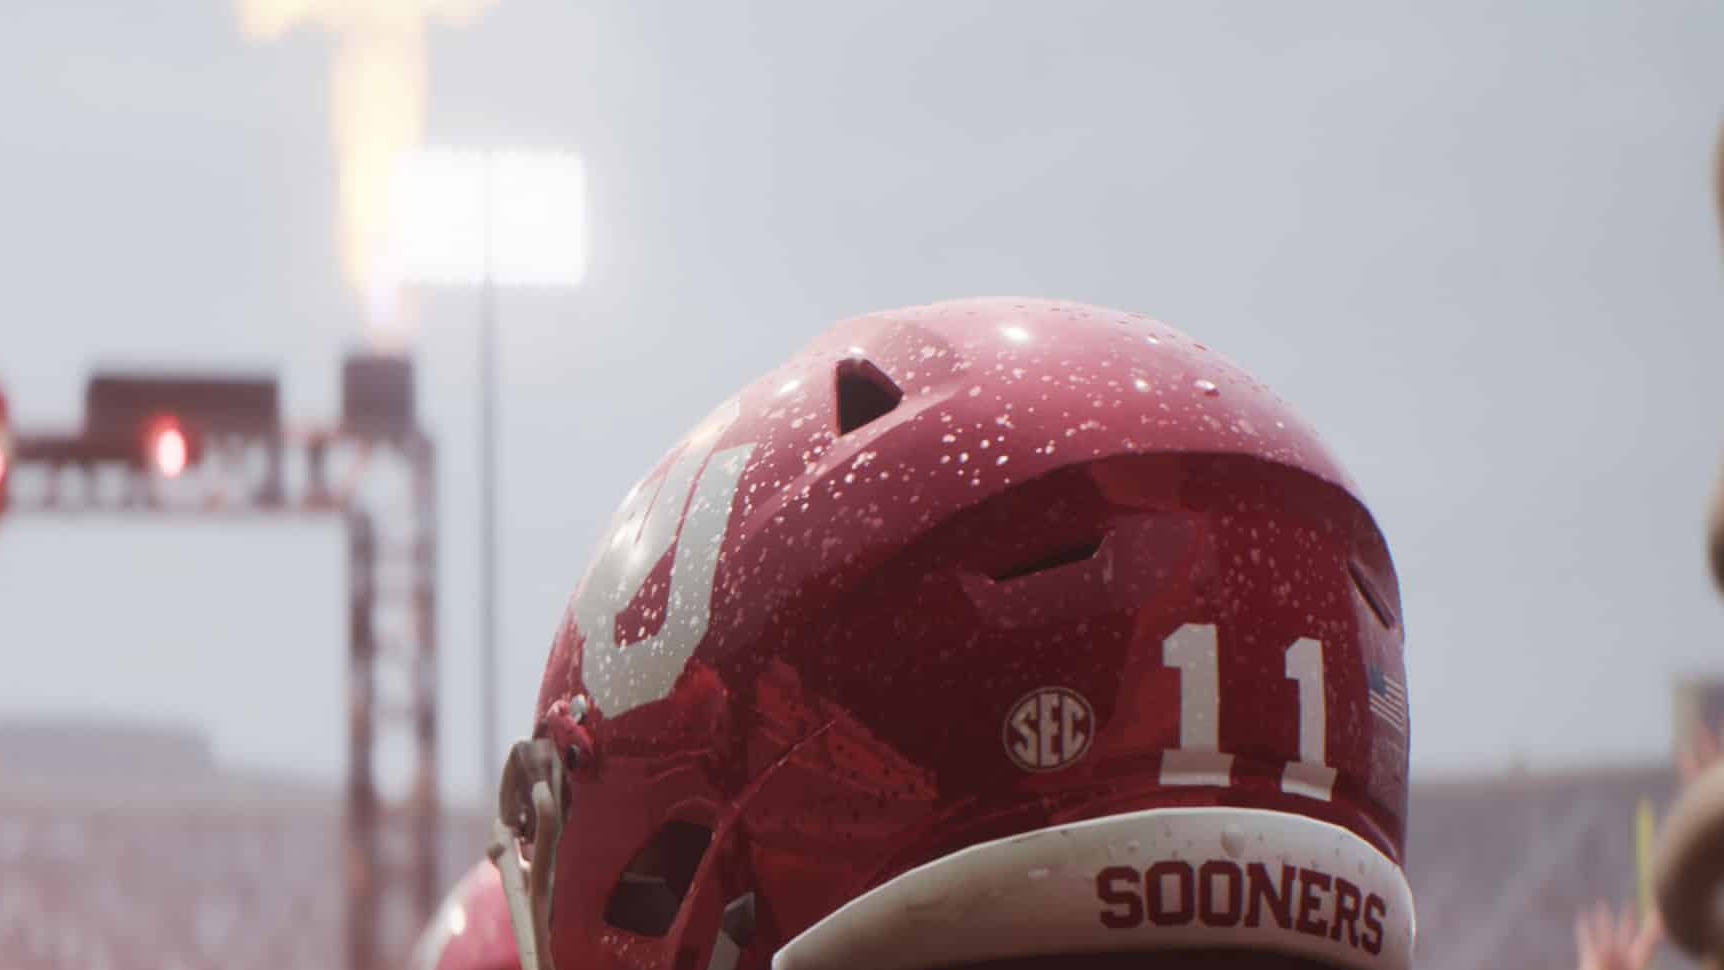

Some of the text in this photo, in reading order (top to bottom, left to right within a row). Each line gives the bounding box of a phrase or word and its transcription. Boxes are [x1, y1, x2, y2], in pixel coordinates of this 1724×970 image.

[1009, 688, 1088, 768] SEC
[1157, 622, 1338, 802] 11
[1095, 859, 1387, 957] SOONERS
